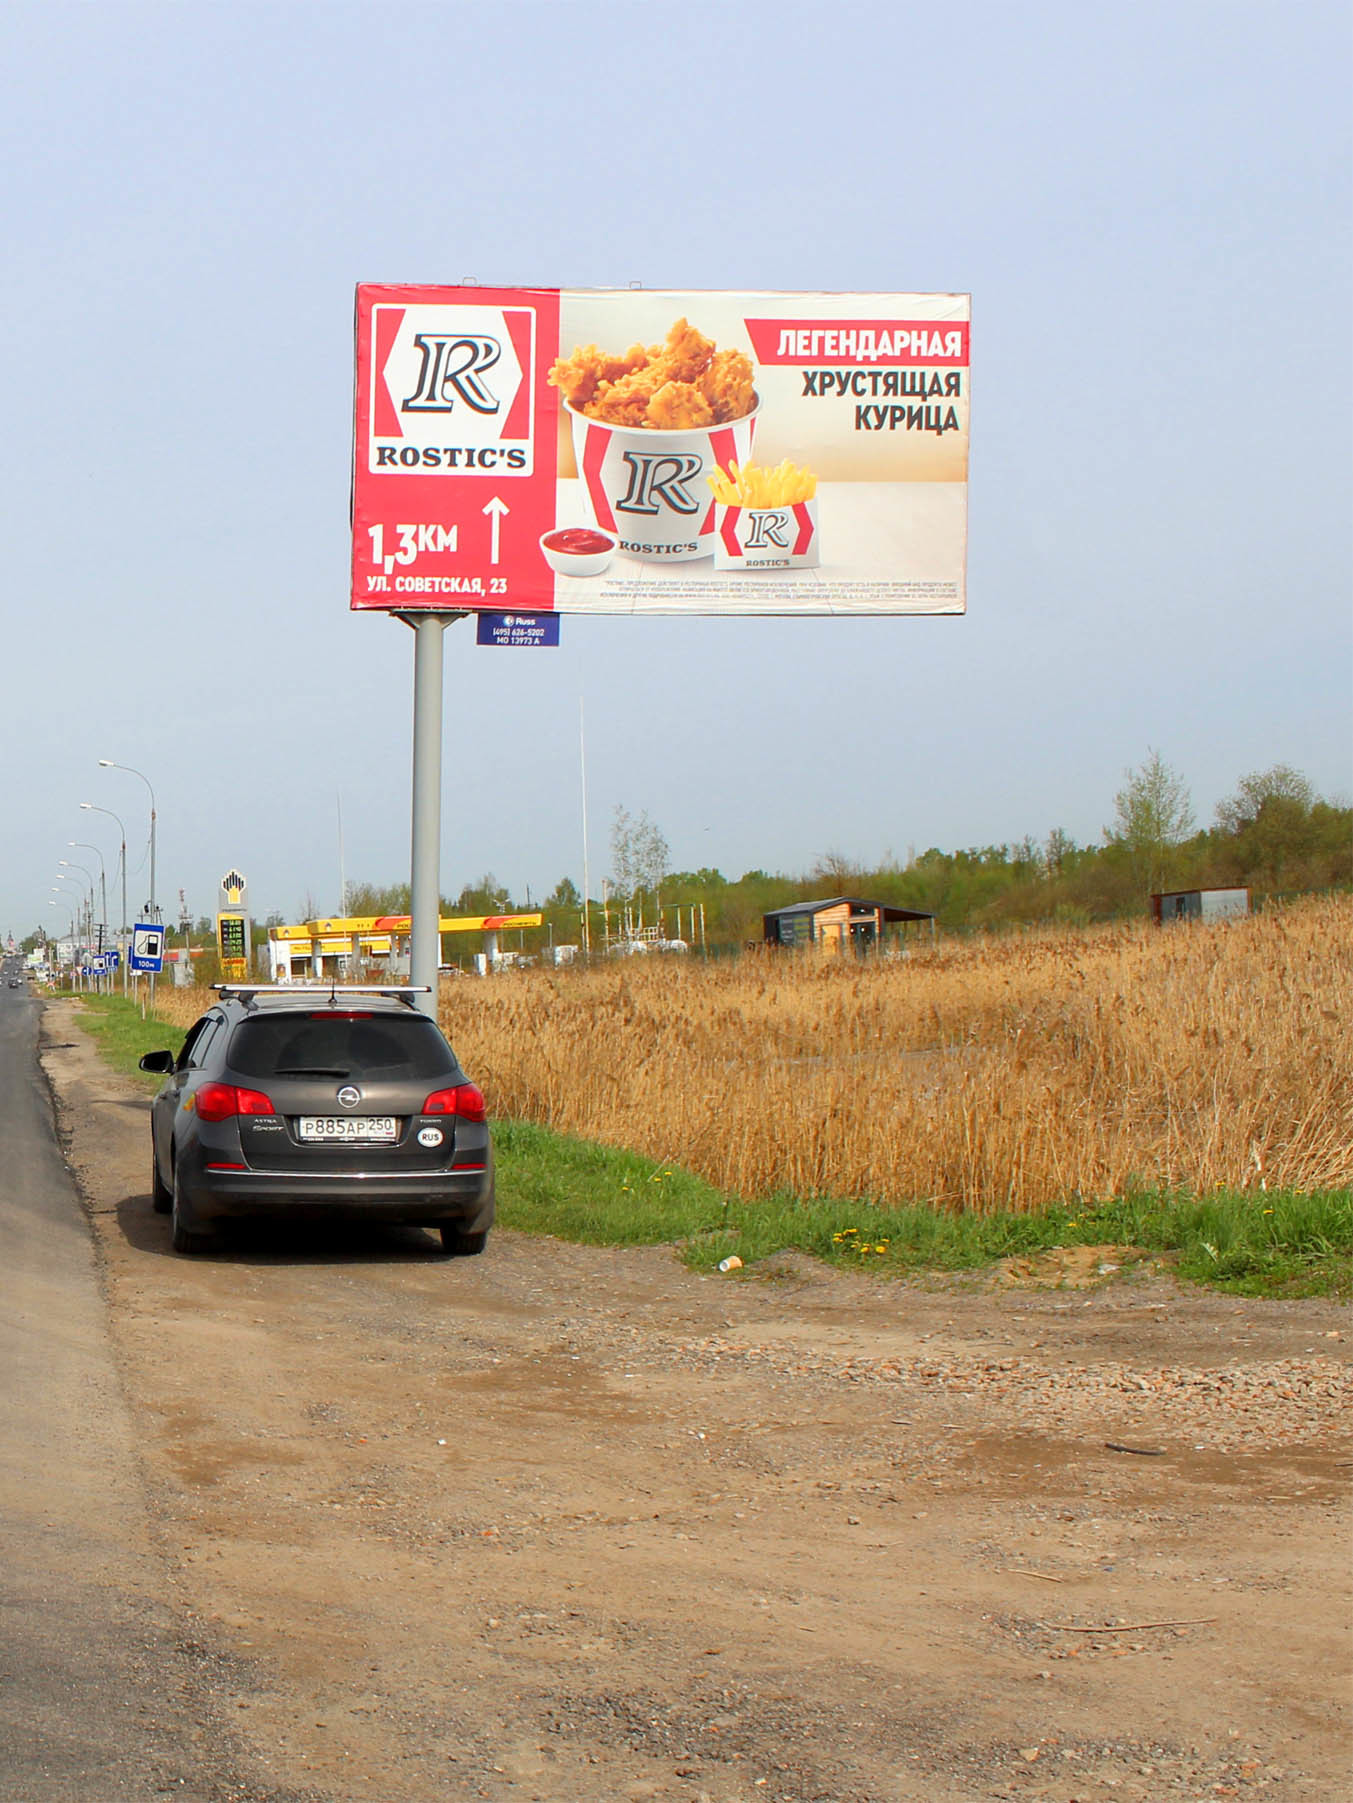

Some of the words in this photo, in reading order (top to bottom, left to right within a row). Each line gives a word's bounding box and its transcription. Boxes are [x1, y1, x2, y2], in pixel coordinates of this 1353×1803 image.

[777, 329, 962, 362] ЛЕГЕНДАРНАЯ
[401, 333, 501, 415] R
[802, 371, 961, 402] ХРУСТЯЩАЯ
[855, 405, 960, 436] КУРИЦА
[376, 446, 527, 469] ROSTIC'S
[615, 451, 703, 516] R
[619, 540, 698, 555] ROSTIC'S
[745, 559, 791, 568] ROSTIC'S
[367, 575, 391, 592] УЛ.
[395, 576, 486, 597] СОВЕТСКАЯ,
[490, 578, 508, 594] 23
[515, 617, 536, 626] Russ
[368, 1118, 392, 1131] 250
[422, 1133, 440, 1141] RUS
